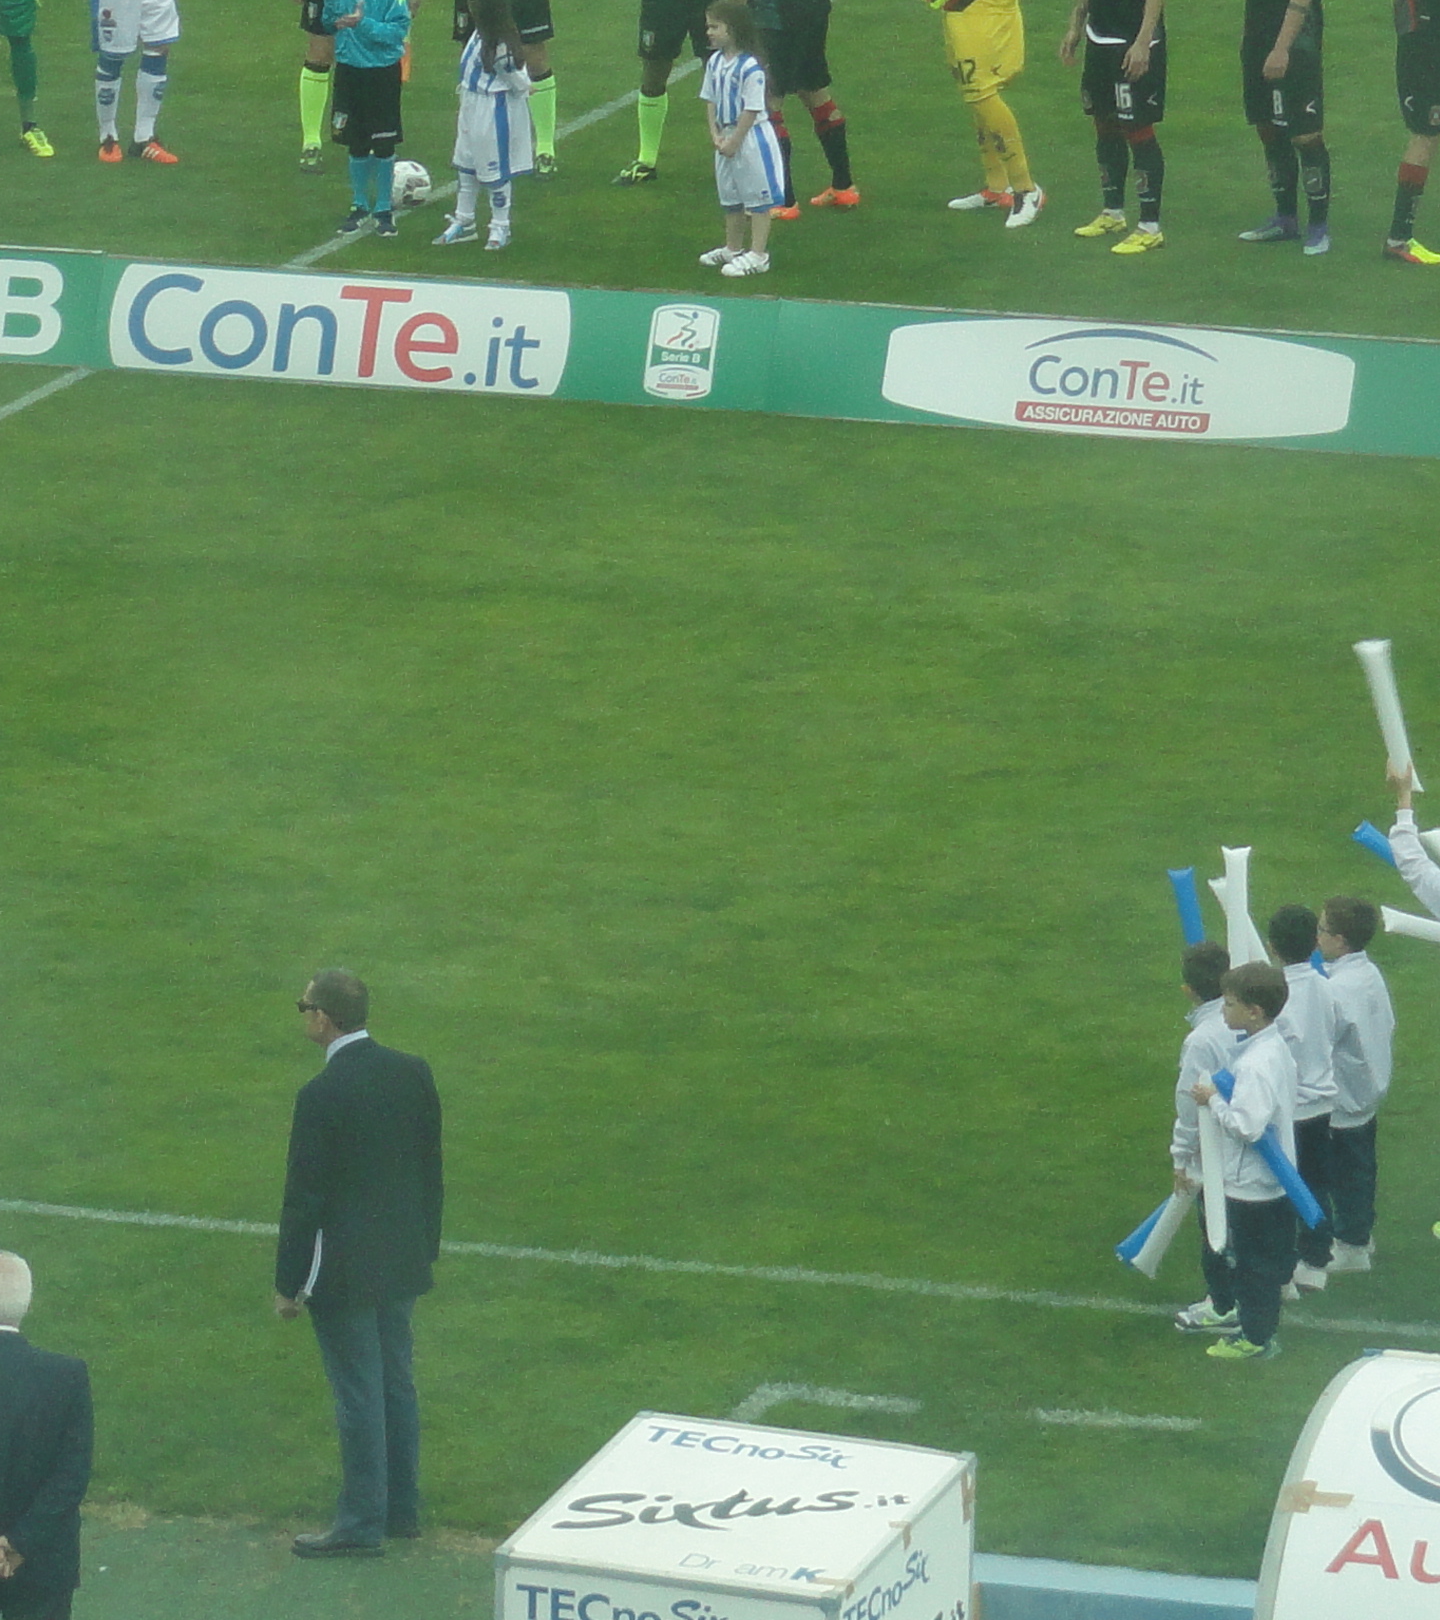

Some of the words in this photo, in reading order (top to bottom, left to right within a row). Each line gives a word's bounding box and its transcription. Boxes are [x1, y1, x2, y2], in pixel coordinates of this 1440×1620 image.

[1114, 82, 1132, 110] 16
[127, 272, 541, 390] ConTe.it
[1028, 354, 1205, 405] ConTe.it
[1022, 404, 1154, 428] ASSICURAZIONE
[1154, 414, 1202, 431] AUTO
